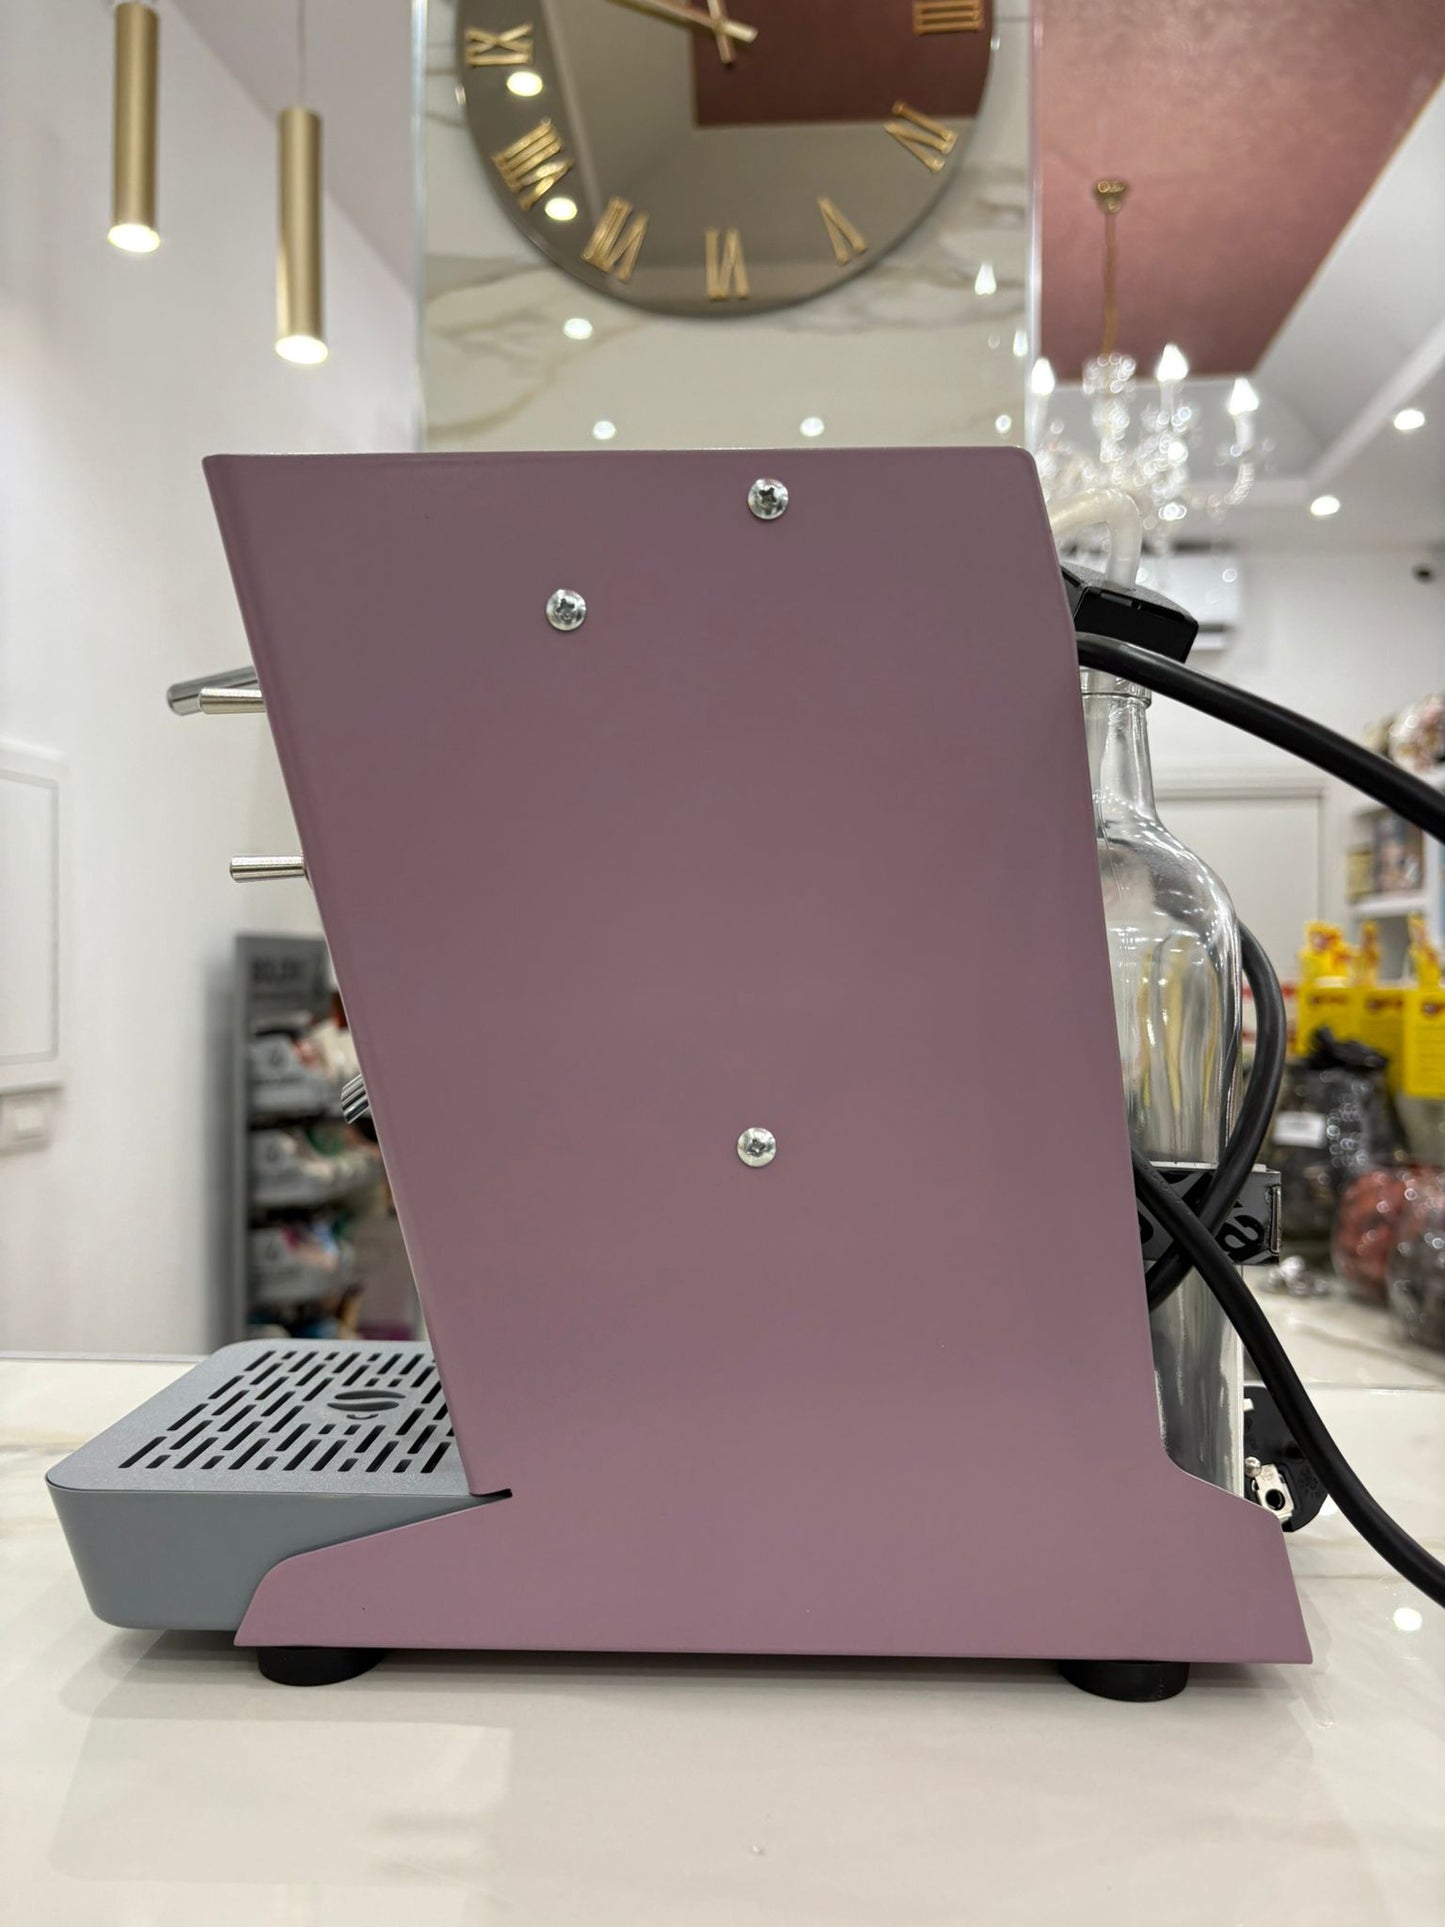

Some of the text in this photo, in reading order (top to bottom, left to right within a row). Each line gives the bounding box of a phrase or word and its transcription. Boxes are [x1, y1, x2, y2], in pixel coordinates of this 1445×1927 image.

[464, 22, 534, 67] IX
[912, 0, 984, 36] III
[491, 116, 575, 211] VIII
[883, 101, 957, 171] IV
[580, 196, 650, 284] VII
[705, 226, 749, 300] VI
[816, 196, 867, 266] V
